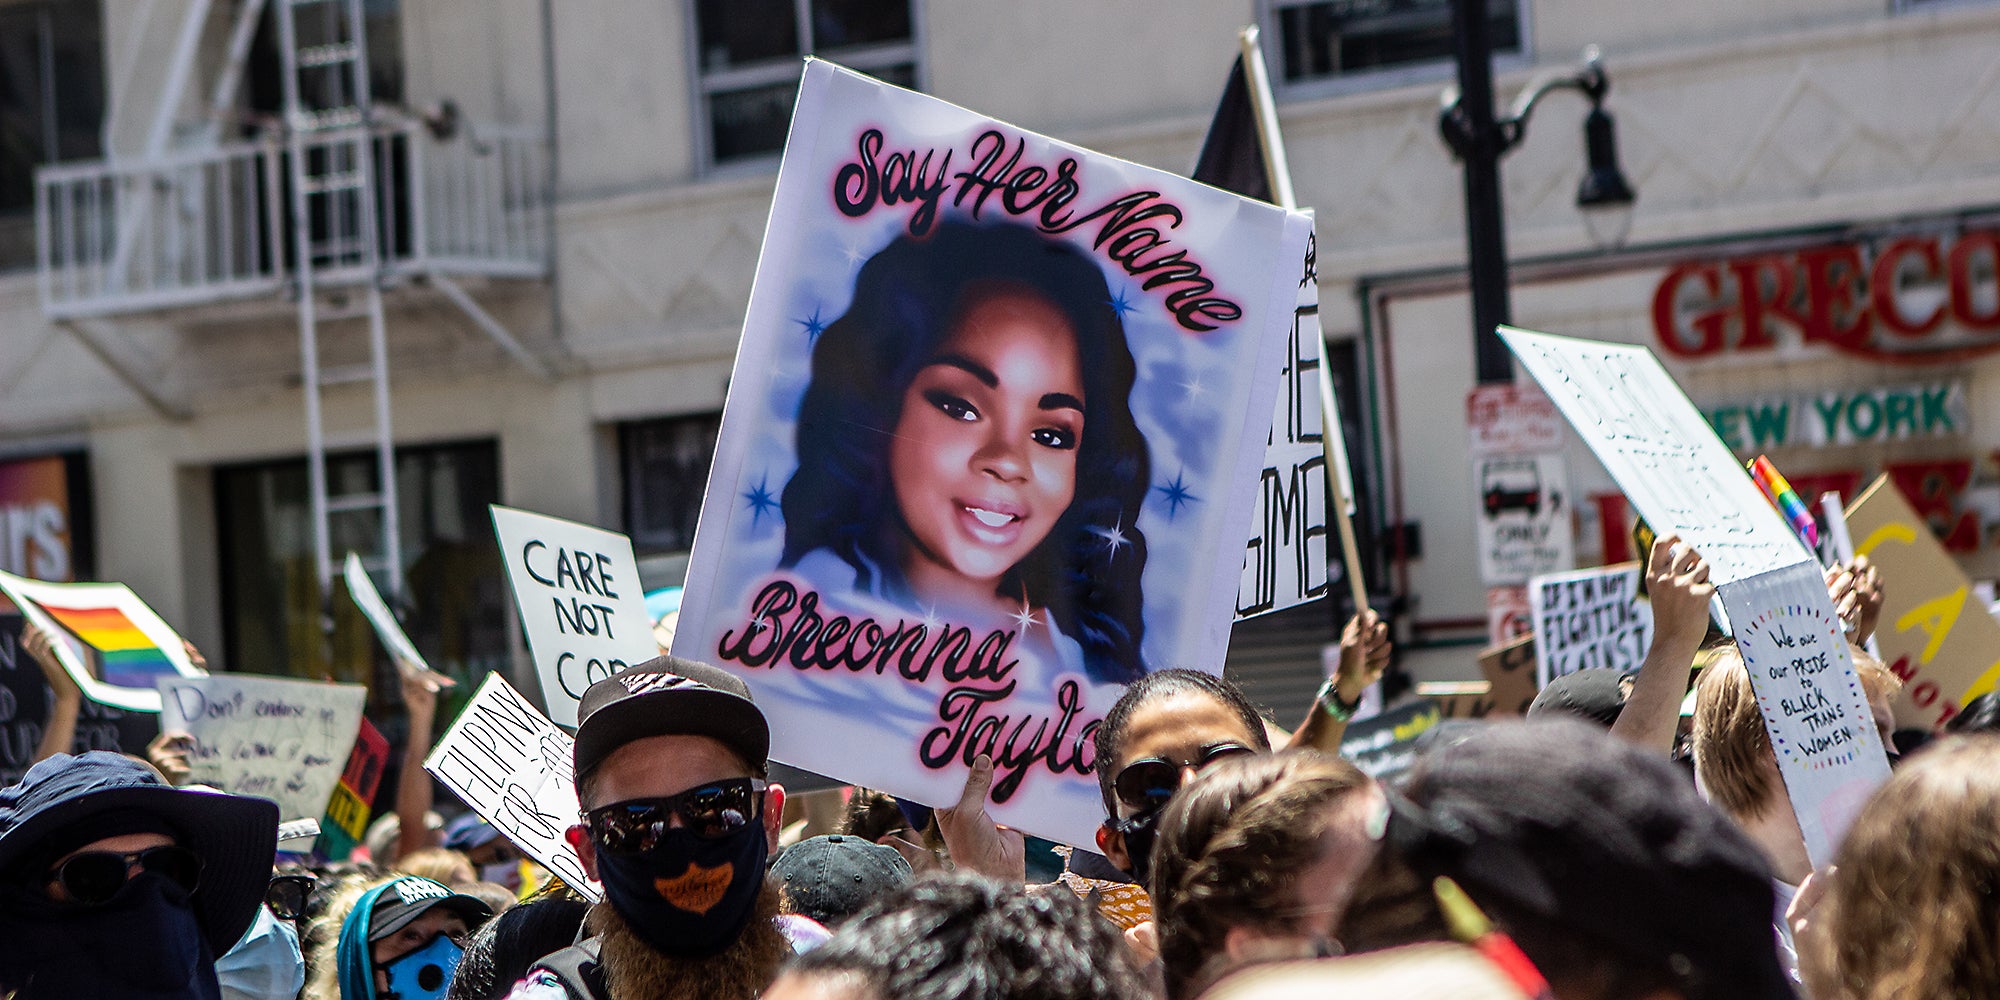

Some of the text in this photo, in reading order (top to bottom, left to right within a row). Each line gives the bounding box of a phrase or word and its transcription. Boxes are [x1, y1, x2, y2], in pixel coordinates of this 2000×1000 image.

[835, 129, 953, 236] Say
[954, 130, 1080, 229] Her
[1037, 191, 1242, 331] Name
[1712, 387, 1954, 450] EW YORK
[523, 540, 619, 599] CARE
[1542, 582, 1560, 610] IF
[1600, 573, 1628, 600] NOT
[552, 597, 615, 639] NOT
[718, 580, 1019, 683] Breonna
[1544, 598, 1639, 650] FIGHTING
[1768, 624, 1795, 648] We
[1769, 652, 1830, 679] our PRIDE
[1801, 676, 1813, 689] to
[1781, 688, 1830, 717] BLACK
[1802, 703, 1845, 734] TRANS
[438, 683, 549, 809] FILIPINX
[919, 679, 1101, 804] Taylo
[1798, 726, 1852, 757] WOMEN
[494, 783, 561, 854] FOR
